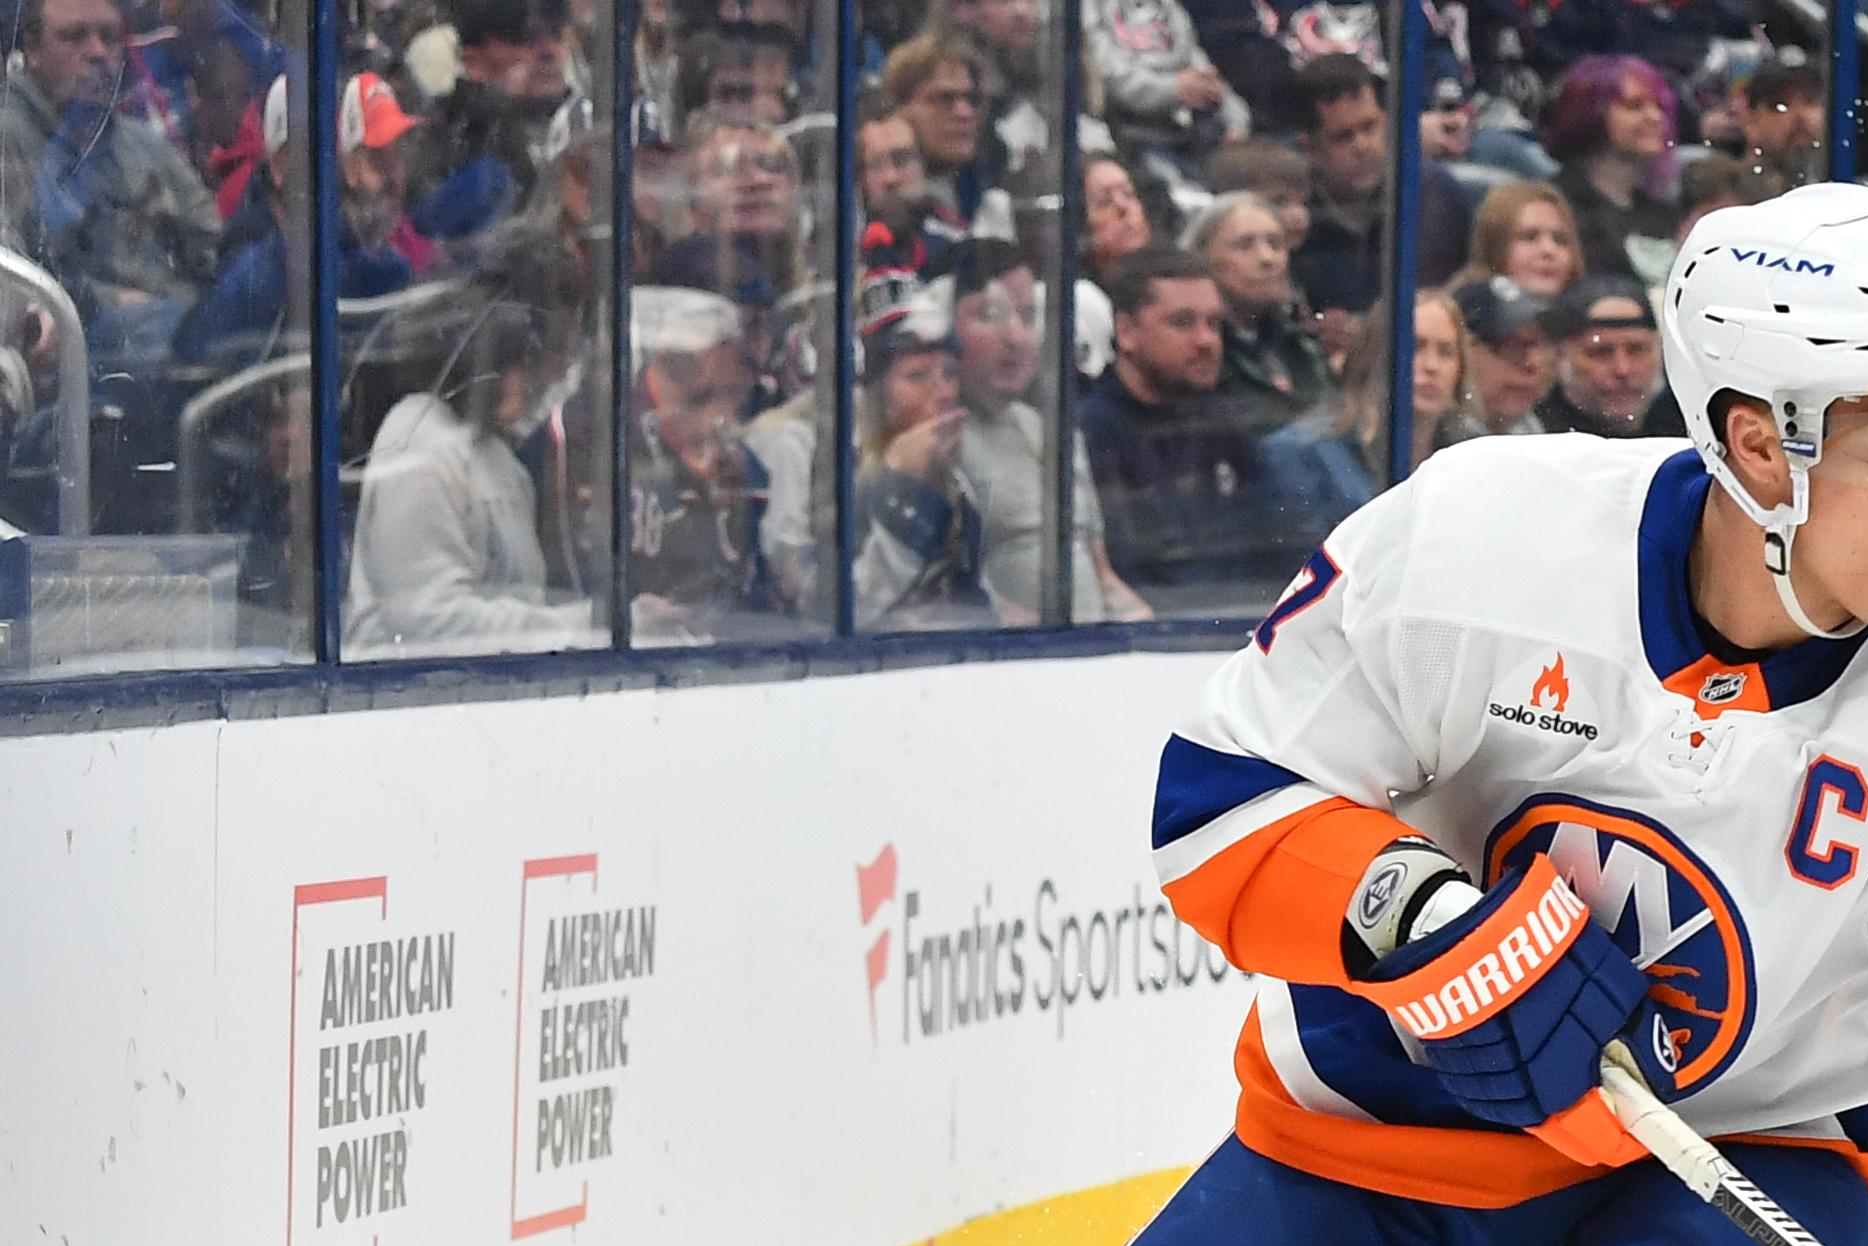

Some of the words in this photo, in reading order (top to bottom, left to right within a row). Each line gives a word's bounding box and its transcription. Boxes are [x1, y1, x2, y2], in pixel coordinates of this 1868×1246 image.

[1730, 247, 1836, 278] VIAM
[1488, 703, 1536, 726] solo
[1538, 713, 1598, 741] stove
[319, 931, 455, 1031] AMERICAN
[541, 905, 657, 994] AMERICAN
[902, 882, 1026, 1045] Fanatics
[1396, 875, 1587, 1037] WARRIOR
[317, 1029, 428, 1130] ELECTRIC
[538, 996, 630, 1083] ELECTRIC
[536, 1084, 615, 1174] POWER
[315, 1128, 408, 1229] POWER
